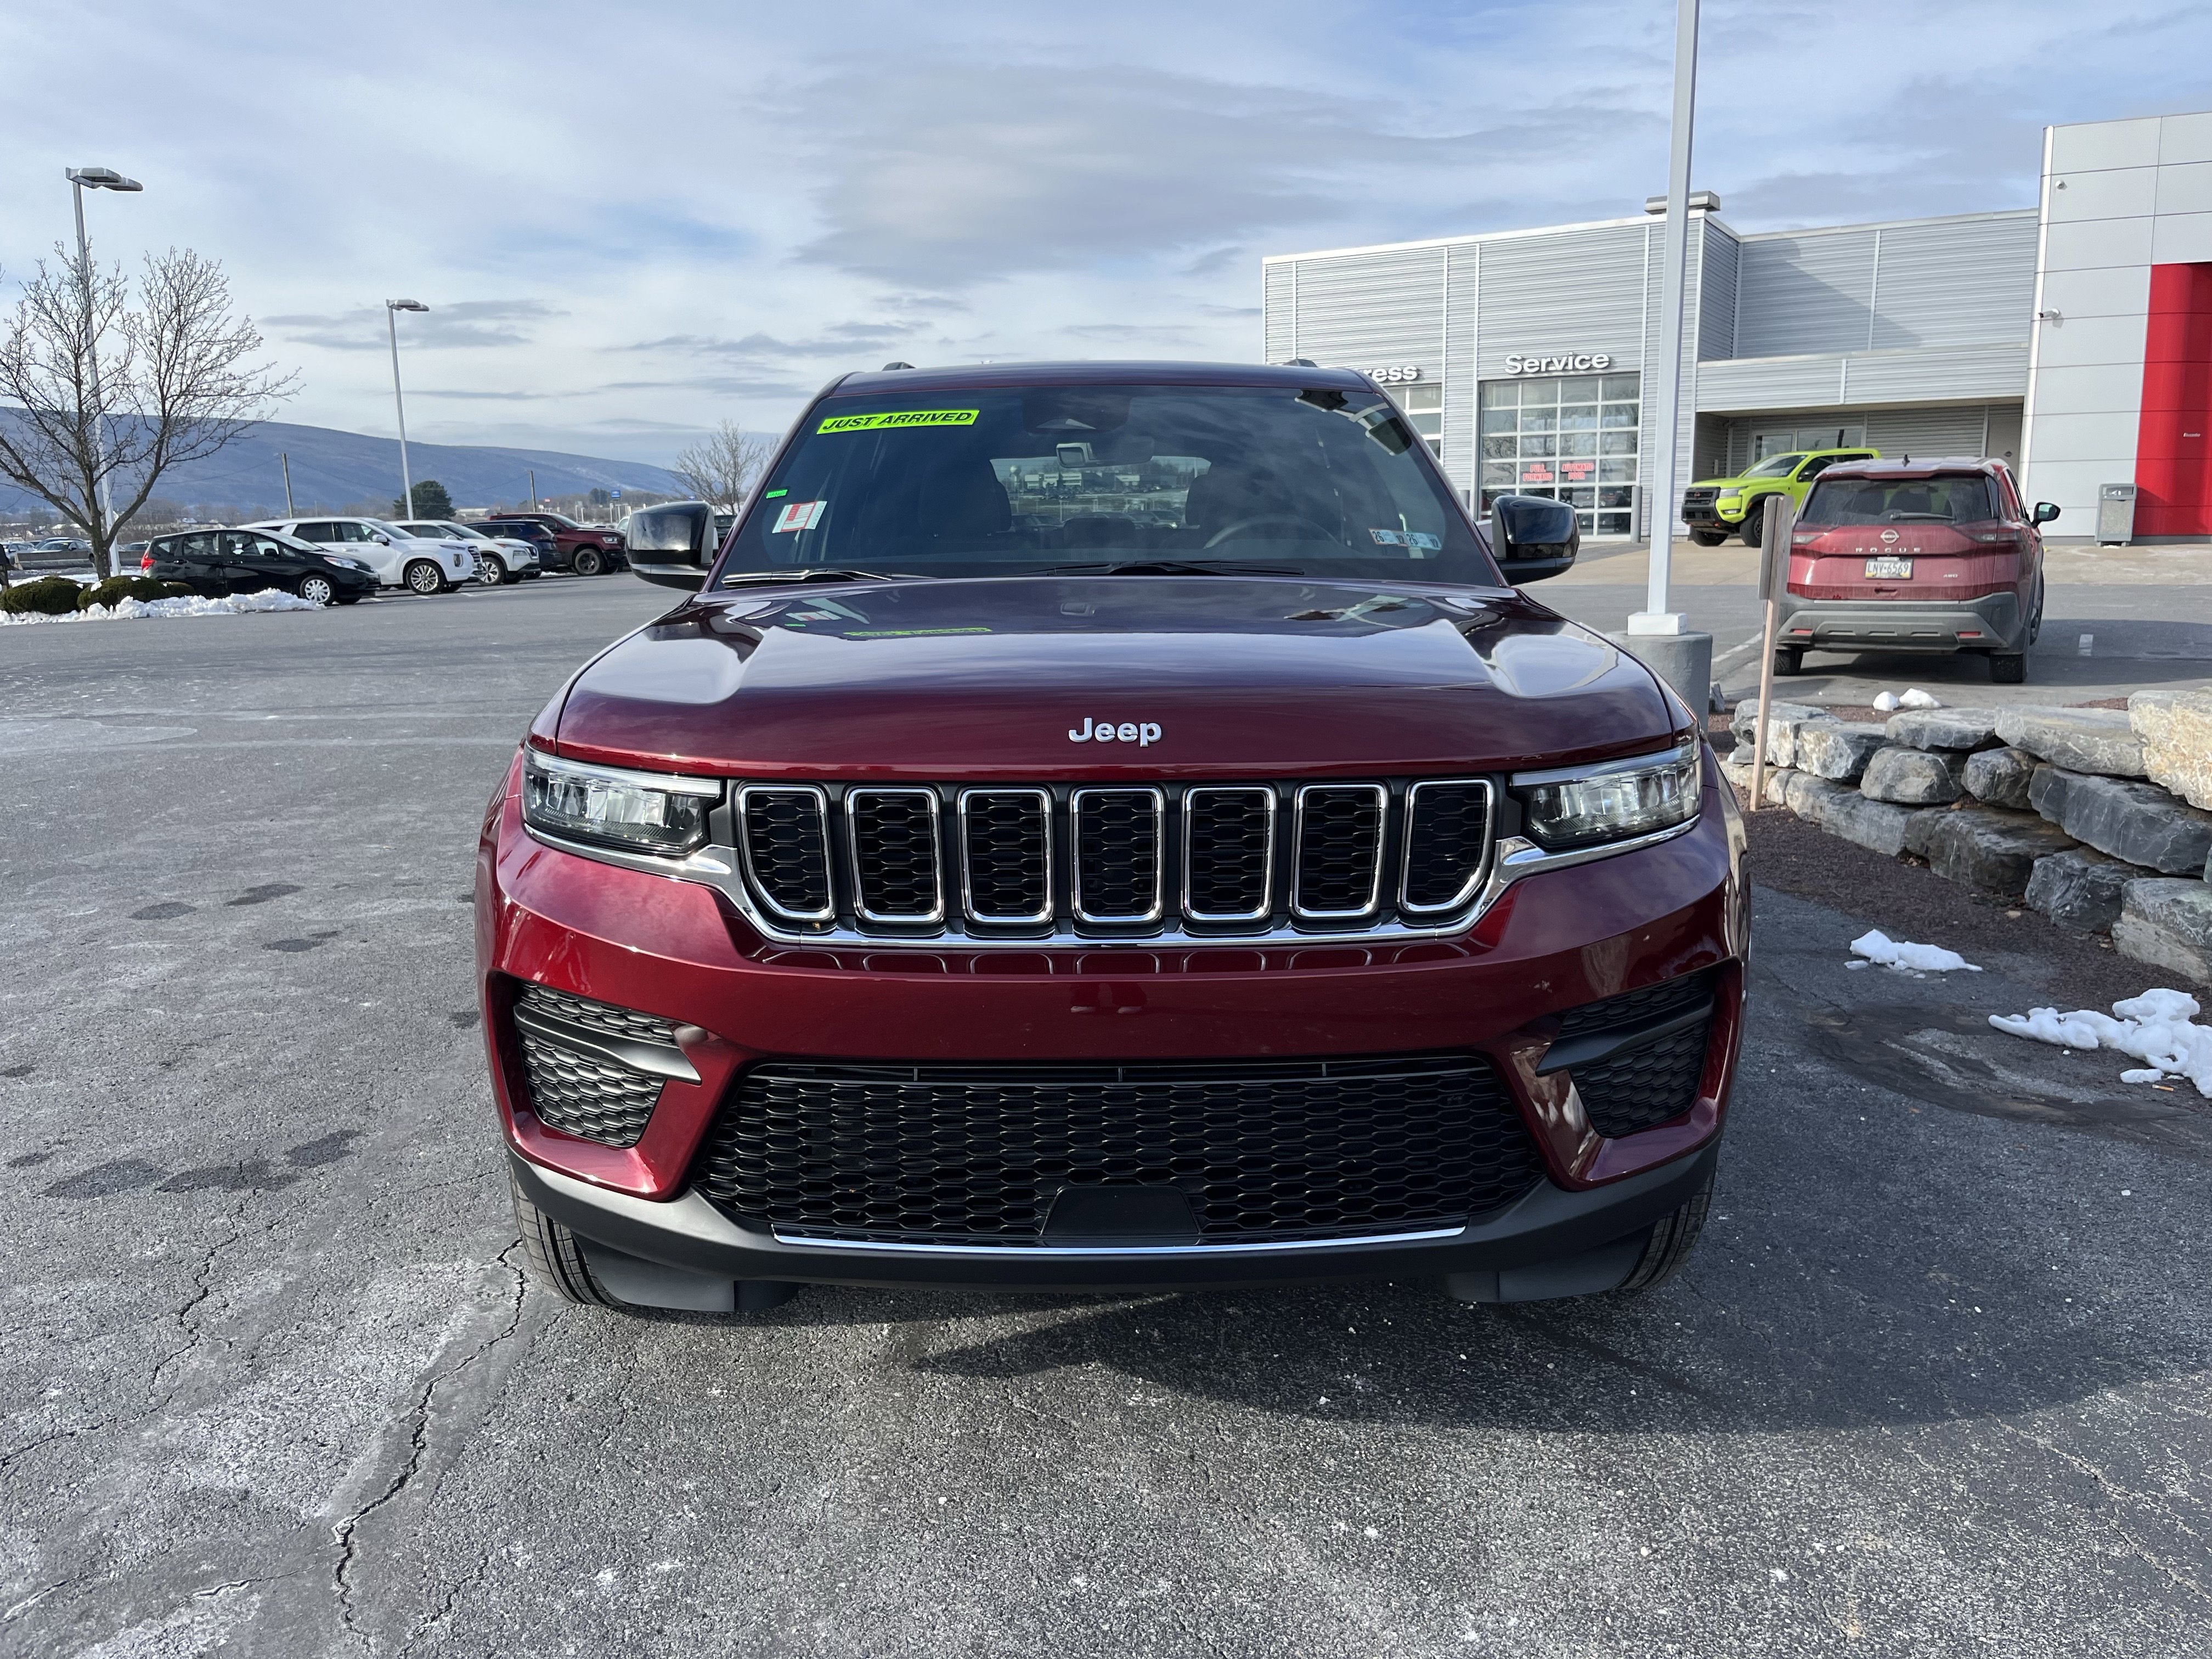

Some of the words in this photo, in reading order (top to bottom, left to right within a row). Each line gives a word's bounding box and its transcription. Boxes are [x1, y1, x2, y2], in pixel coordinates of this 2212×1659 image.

[1504, 352, 1610, 374] Service
[1363, 366, 1418, 382] ress
[823, 416, 879, 430] JUST
[878, 412, 974, 426] ARRIVED
[1562, 463, 1594, 472] AUTOMATIC
[1523, 473, 1553, 481] FORWARD
[1373, 531, 1384, 542] 26
[1406, 533, 1418, 545] 26
[1068, 717, 1162, 747] Jeep
